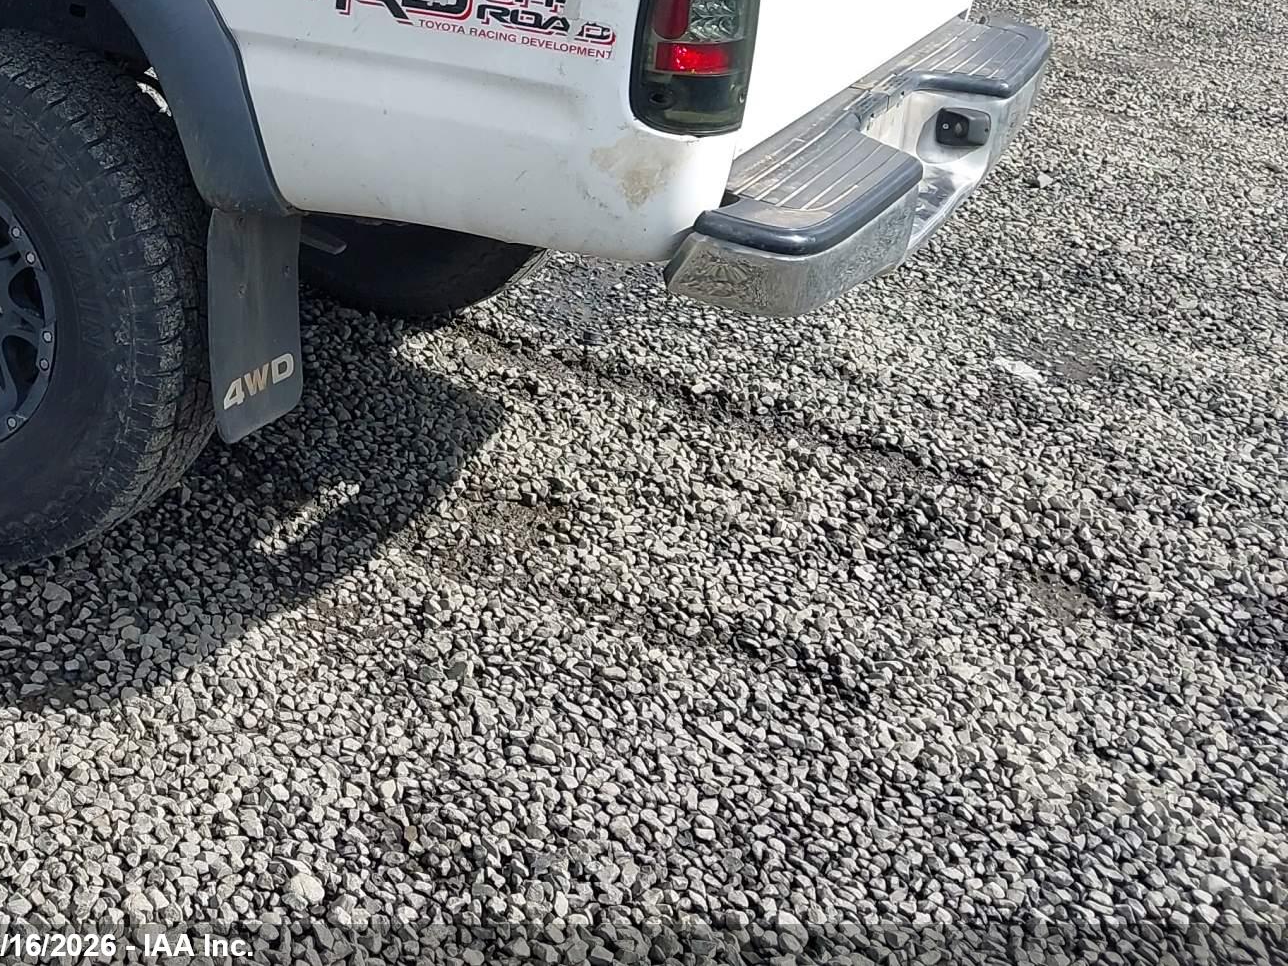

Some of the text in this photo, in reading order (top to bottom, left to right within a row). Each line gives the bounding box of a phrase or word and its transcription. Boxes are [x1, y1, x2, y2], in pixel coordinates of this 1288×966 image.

[418, 18, 613, 59] TOYOTA RACING DEVELOPMENT
[223, 353, 295, 411] 4WD
